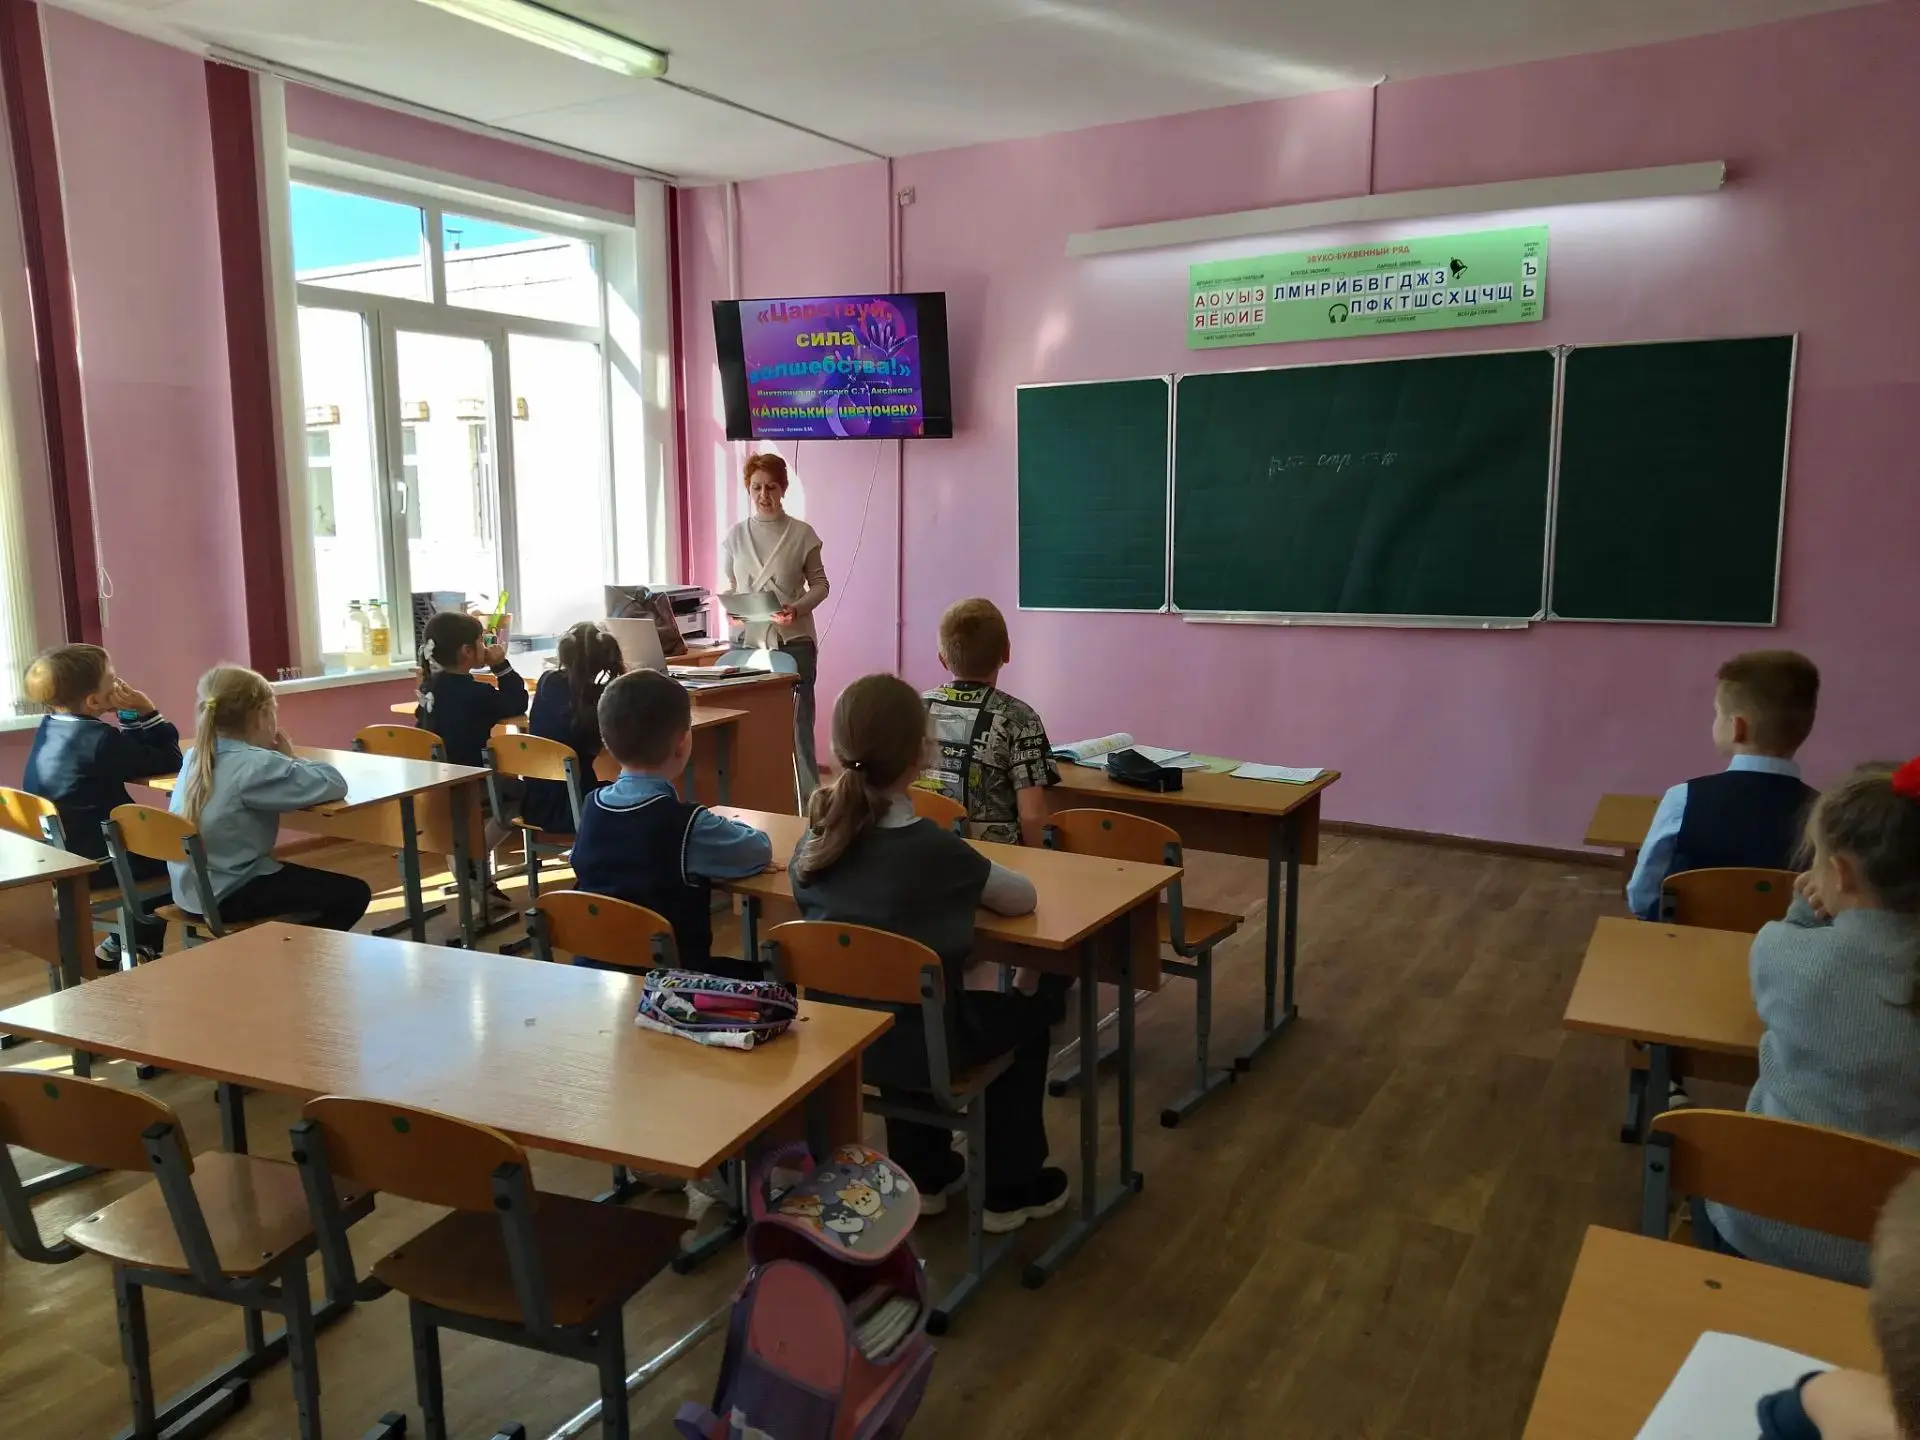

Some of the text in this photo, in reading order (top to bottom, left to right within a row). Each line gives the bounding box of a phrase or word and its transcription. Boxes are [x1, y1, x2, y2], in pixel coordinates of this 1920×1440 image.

[1393, 245, 1410, 255] РЯД
[796, 330, 857, 348] сила
[752, 402, 917, 419] «Аленький цветочек»
